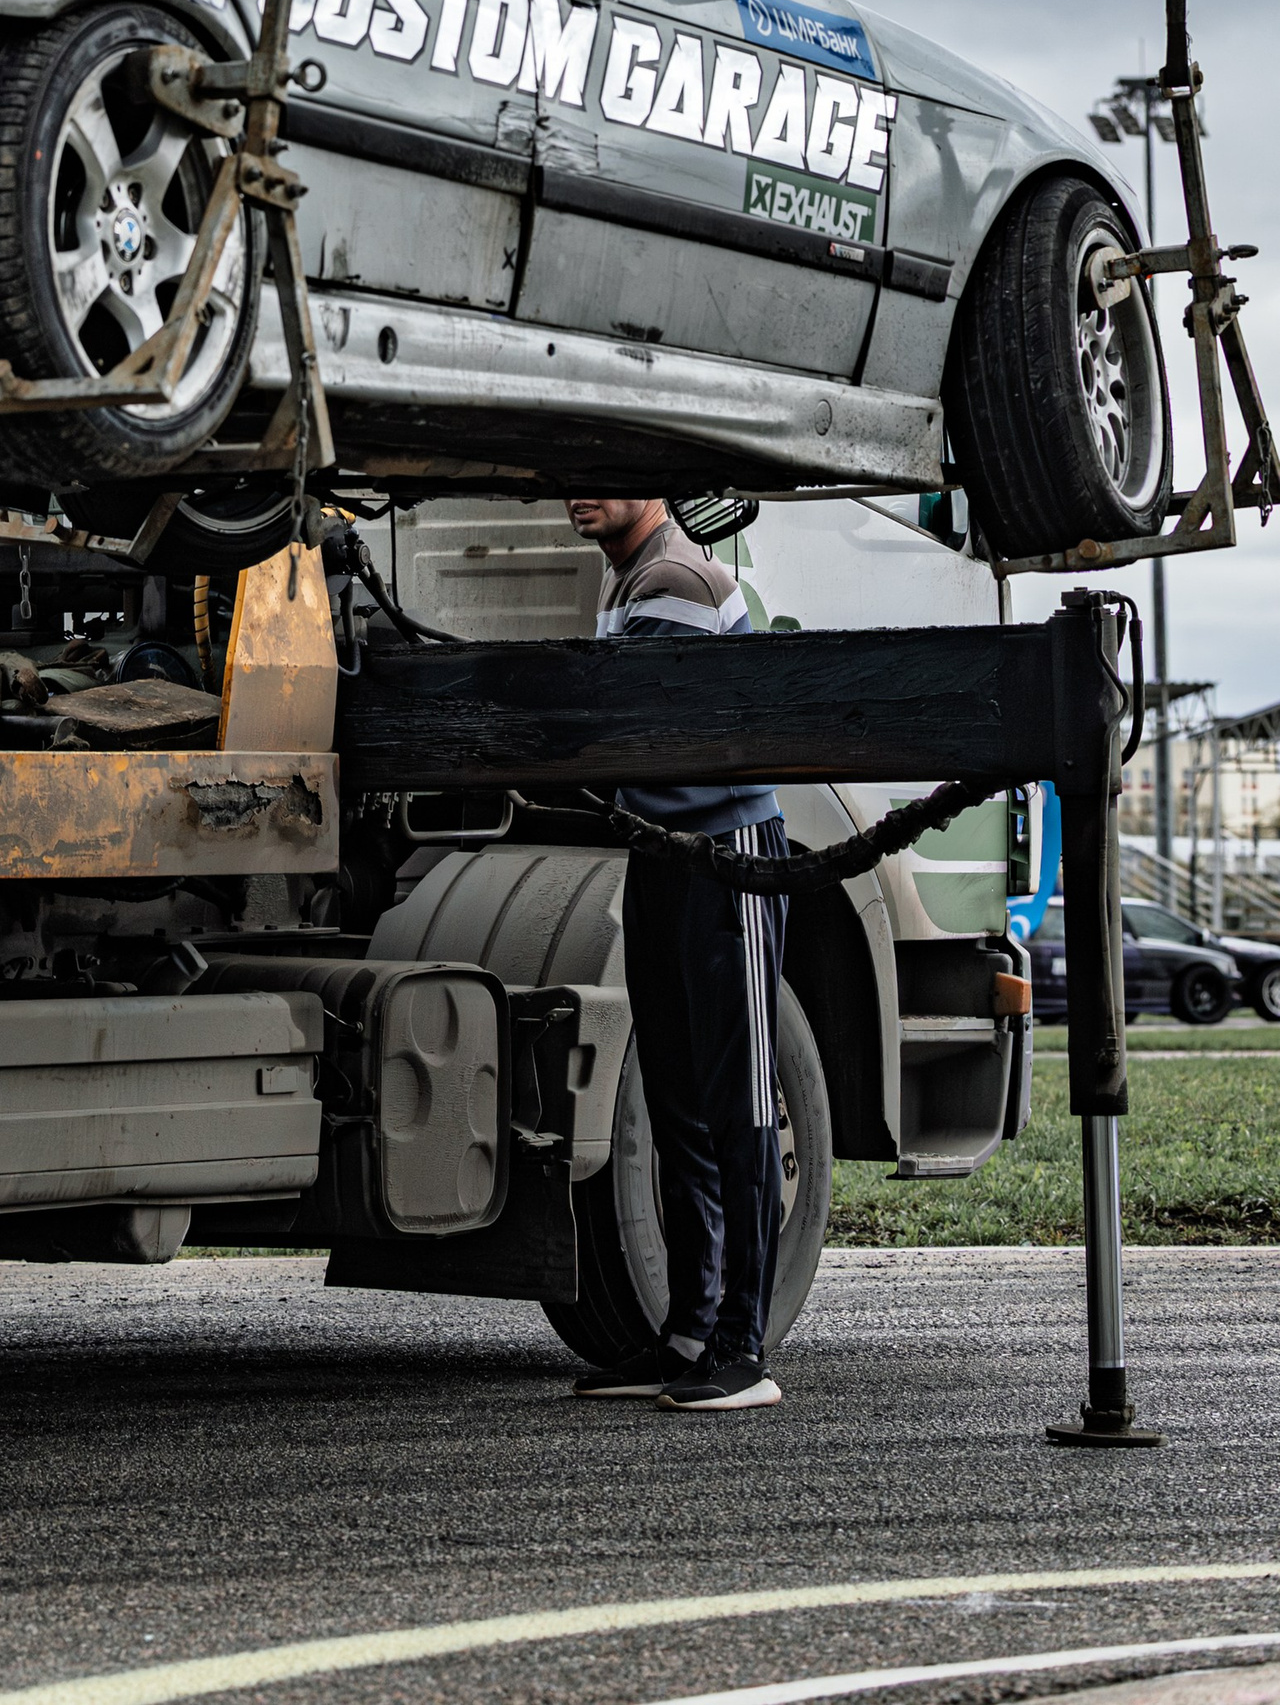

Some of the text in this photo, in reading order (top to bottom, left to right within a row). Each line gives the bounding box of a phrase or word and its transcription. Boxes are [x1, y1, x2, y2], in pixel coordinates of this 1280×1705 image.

[772, 7, 862, 60] ЦМРБанк
[600, 10, 897, 193] GARAGE
[771, 180, 870, 243] EXHAUST
